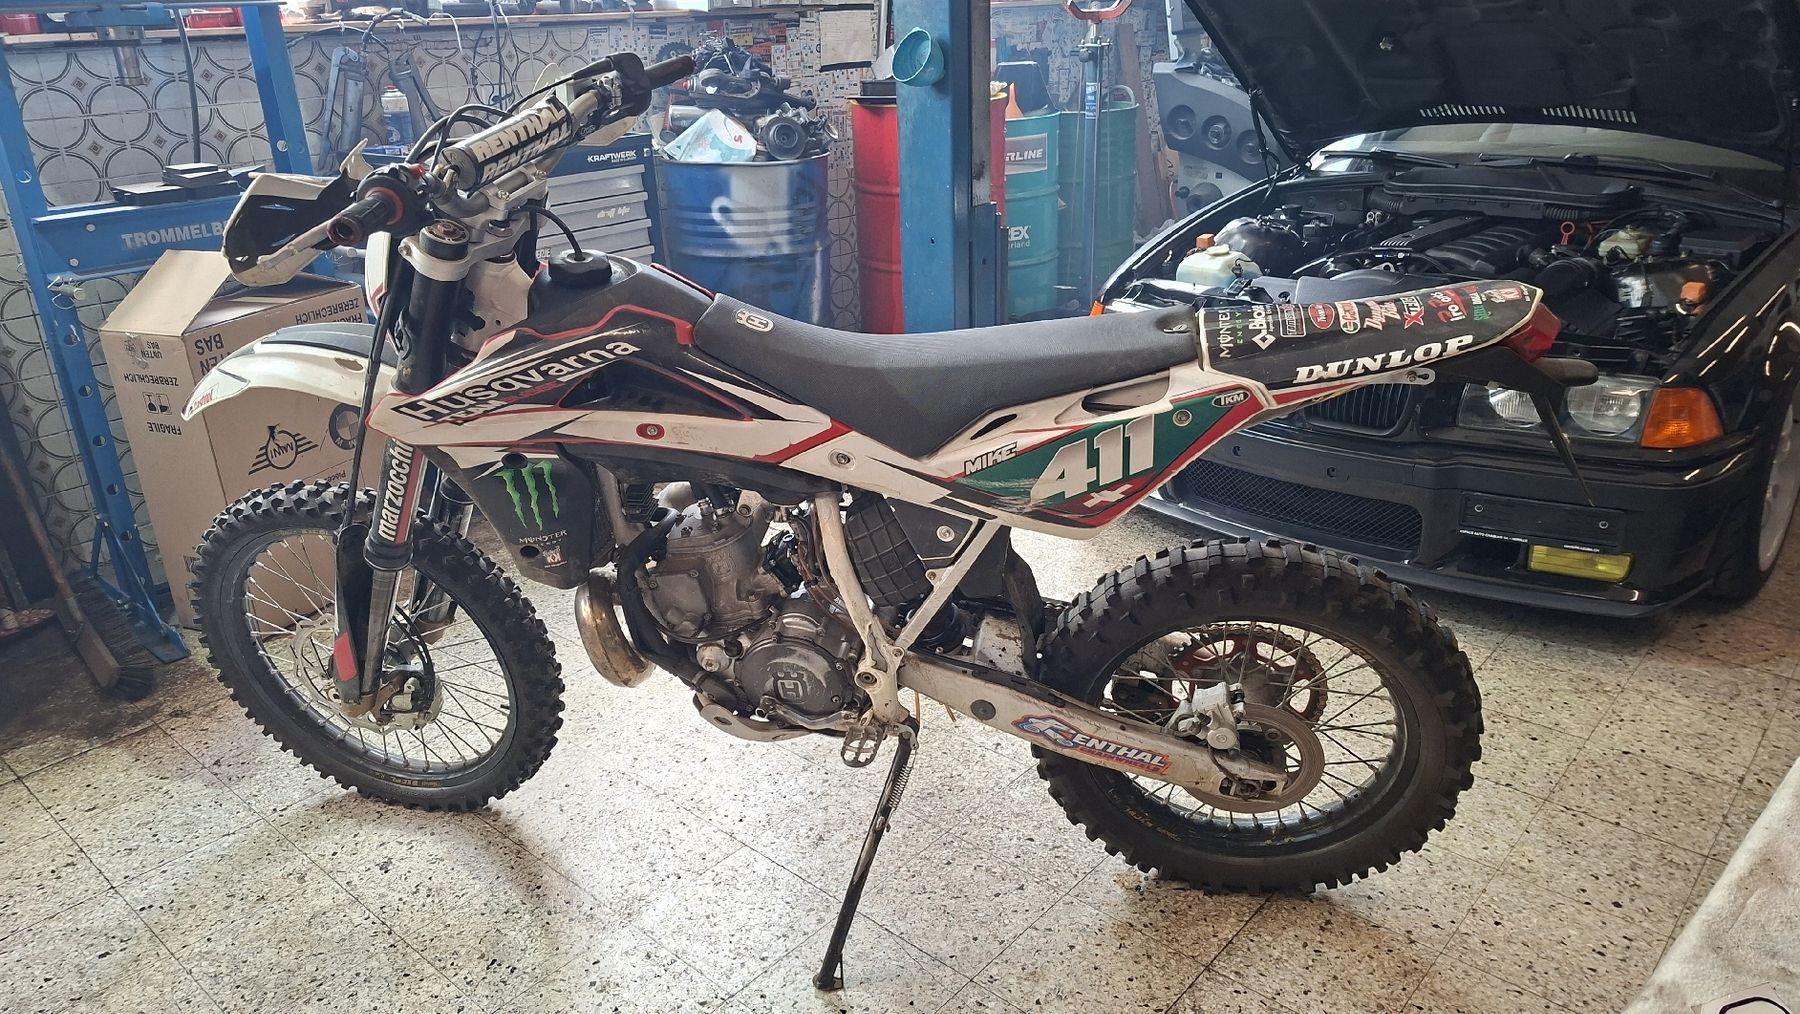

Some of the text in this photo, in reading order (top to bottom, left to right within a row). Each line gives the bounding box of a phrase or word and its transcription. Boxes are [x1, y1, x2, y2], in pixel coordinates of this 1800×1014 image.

[470, 103, 566, 161] RENTHAL
[587, 150, 636, 163] KRAFTWERK
[121, 221, 228, 249] TROMMELB
[296, 298, 359, 324] ZERBRECHLICH
[147, 340, 160, 350] BAS
[195, 333, 224, 355] BAS
[1292, 334, 1474, 384] DUNLOP
[124, 373, 179, 387] ZERBRECHLICH
[400, 340, 642, 420] Husqvarna
[1216, 393, 1244, 406] TKM
[147, 421, 182, 435] FRAGILE
[270, 442, 294, 459] MINI
[965, 441, 1018, 475] MIKE
[1031, 414, 1154, 503] 411
[378, 438, 414, 542] marzocchi
